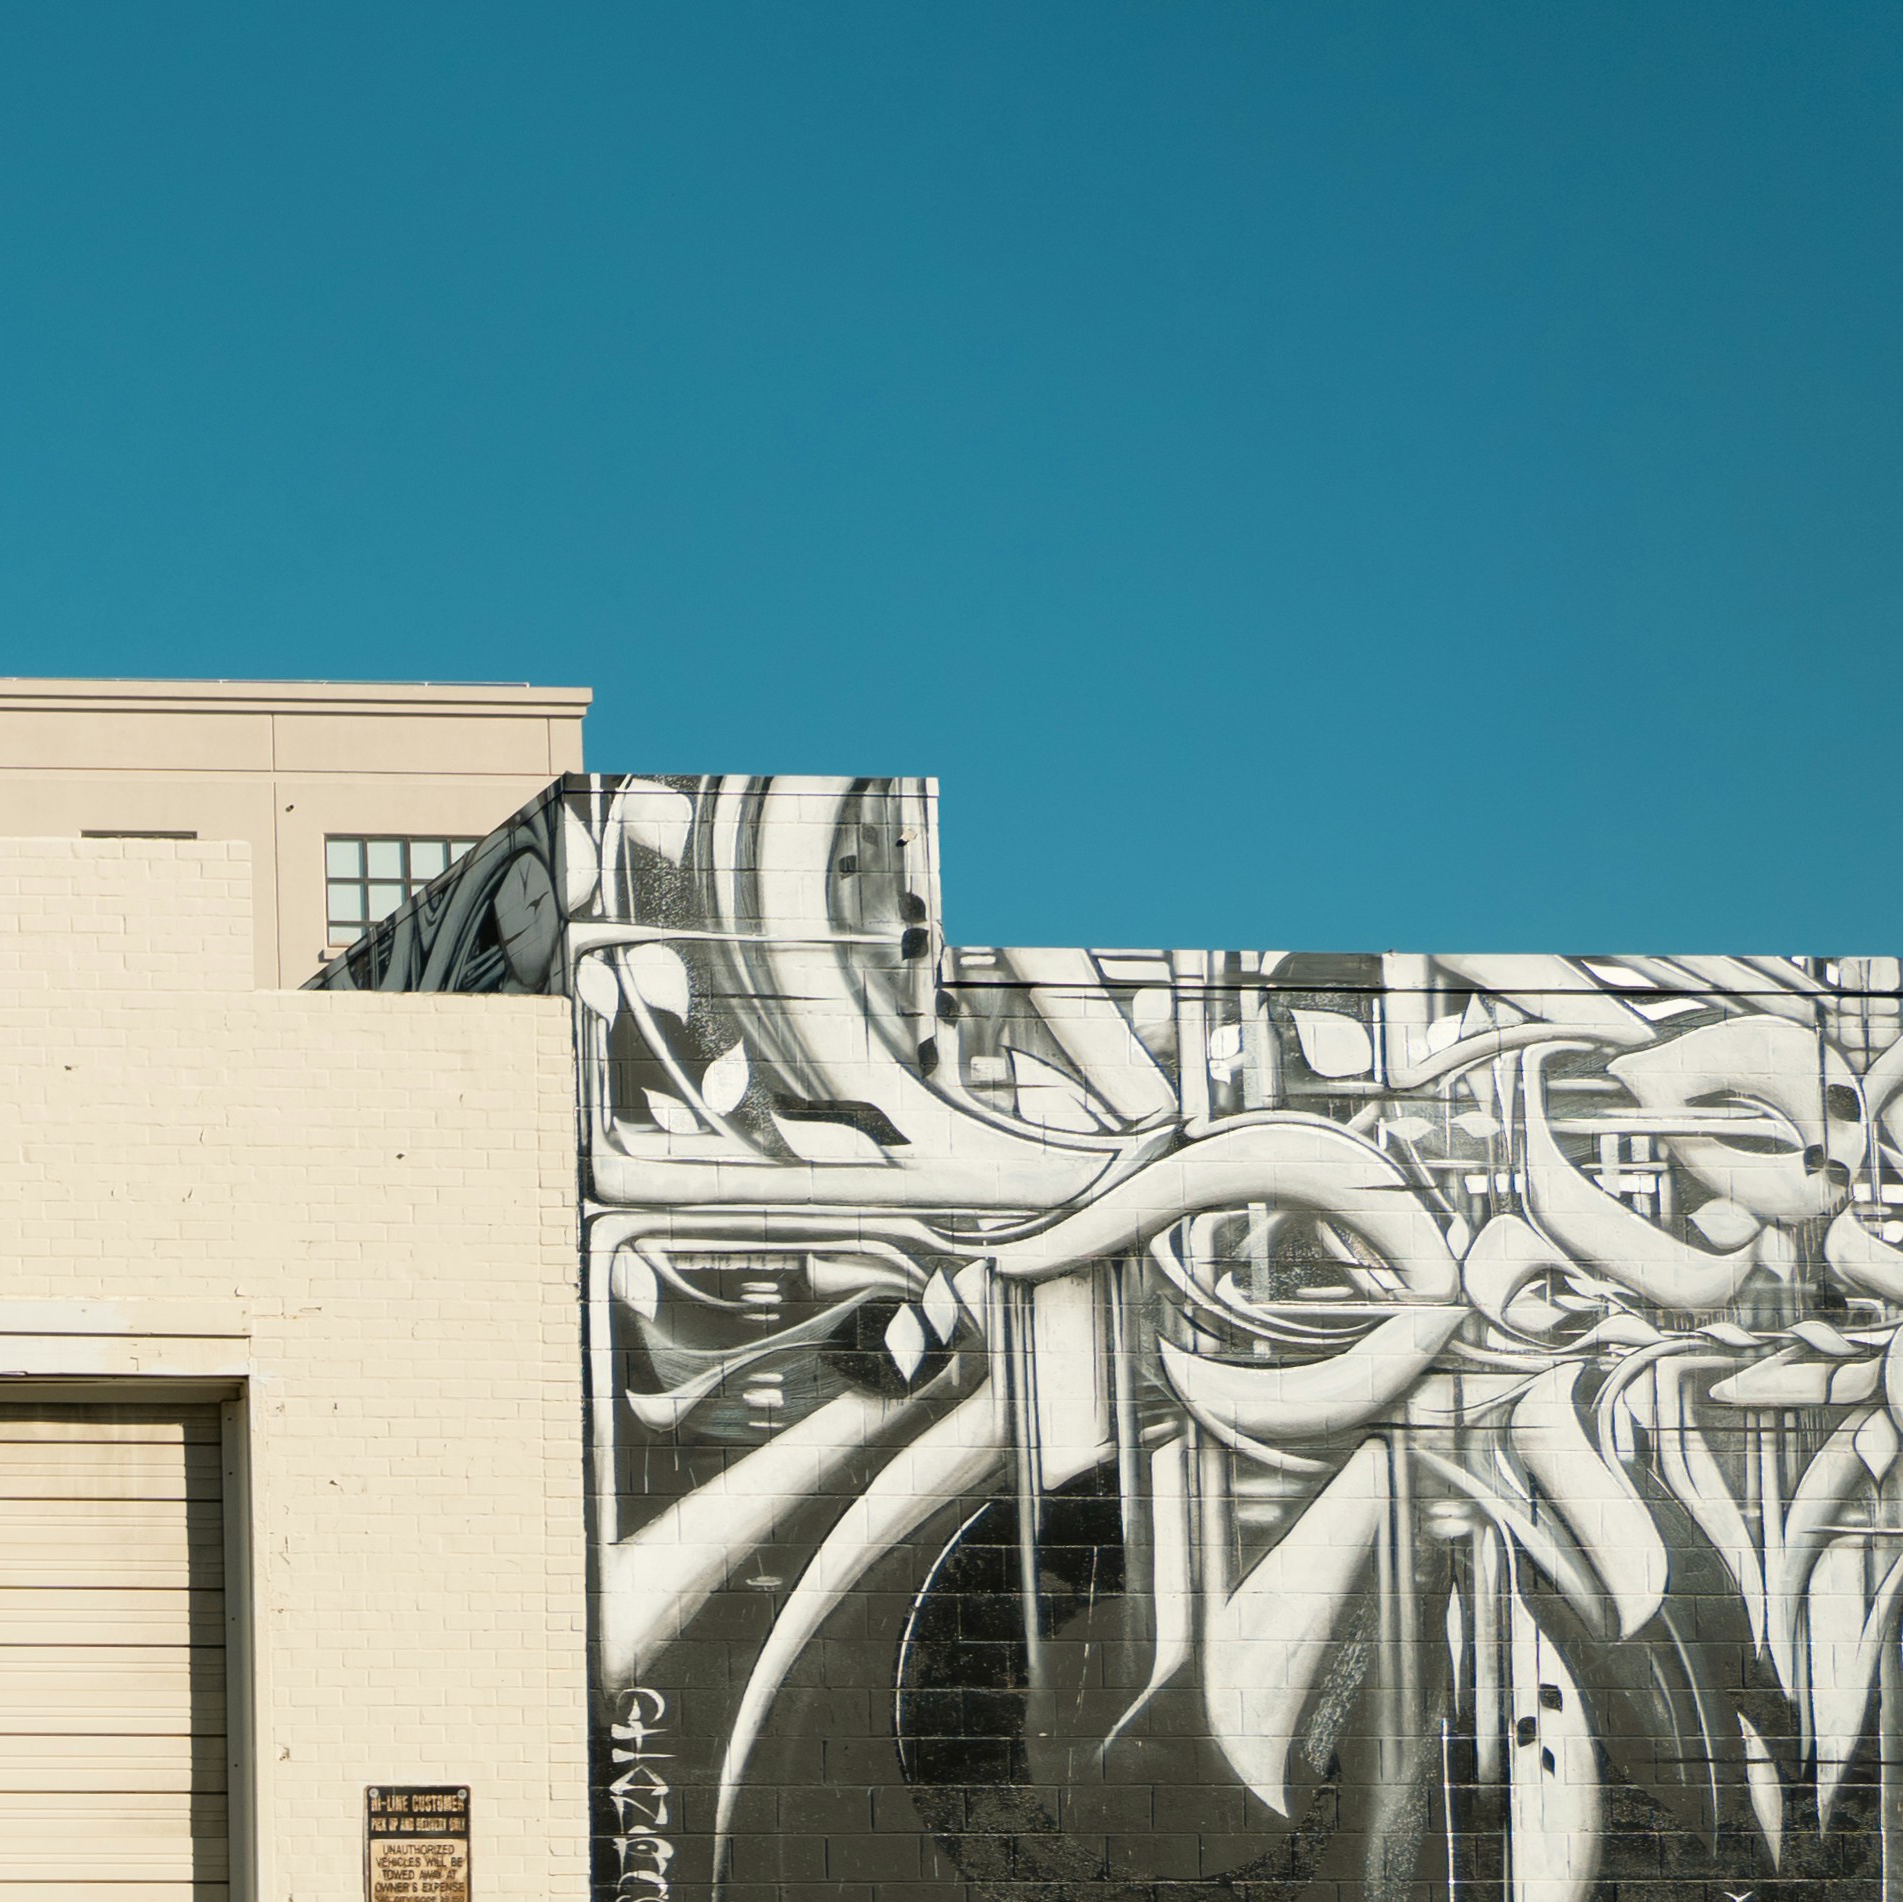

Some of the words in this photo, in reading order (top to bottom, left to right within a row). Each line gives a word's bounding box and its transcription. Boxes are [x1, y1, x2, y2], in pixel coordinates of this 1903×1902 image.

[412, 1795, 464, 1812] CUSTOMER
[383, 1844, 455, 1855] UNAUTHORIZED
[376, 1857, 421, 1867] VEHICLES
[426, 1857, 447, 1867] WILL
[450, 1857, 463, 1867] BE
[382, 1869, 415, 1880] TOWED
[419, 1869, 442, 1880] AWAY
[446, 1869, 457, 1880] AT
[422, 1882, 465, 1892] EXPENSE
